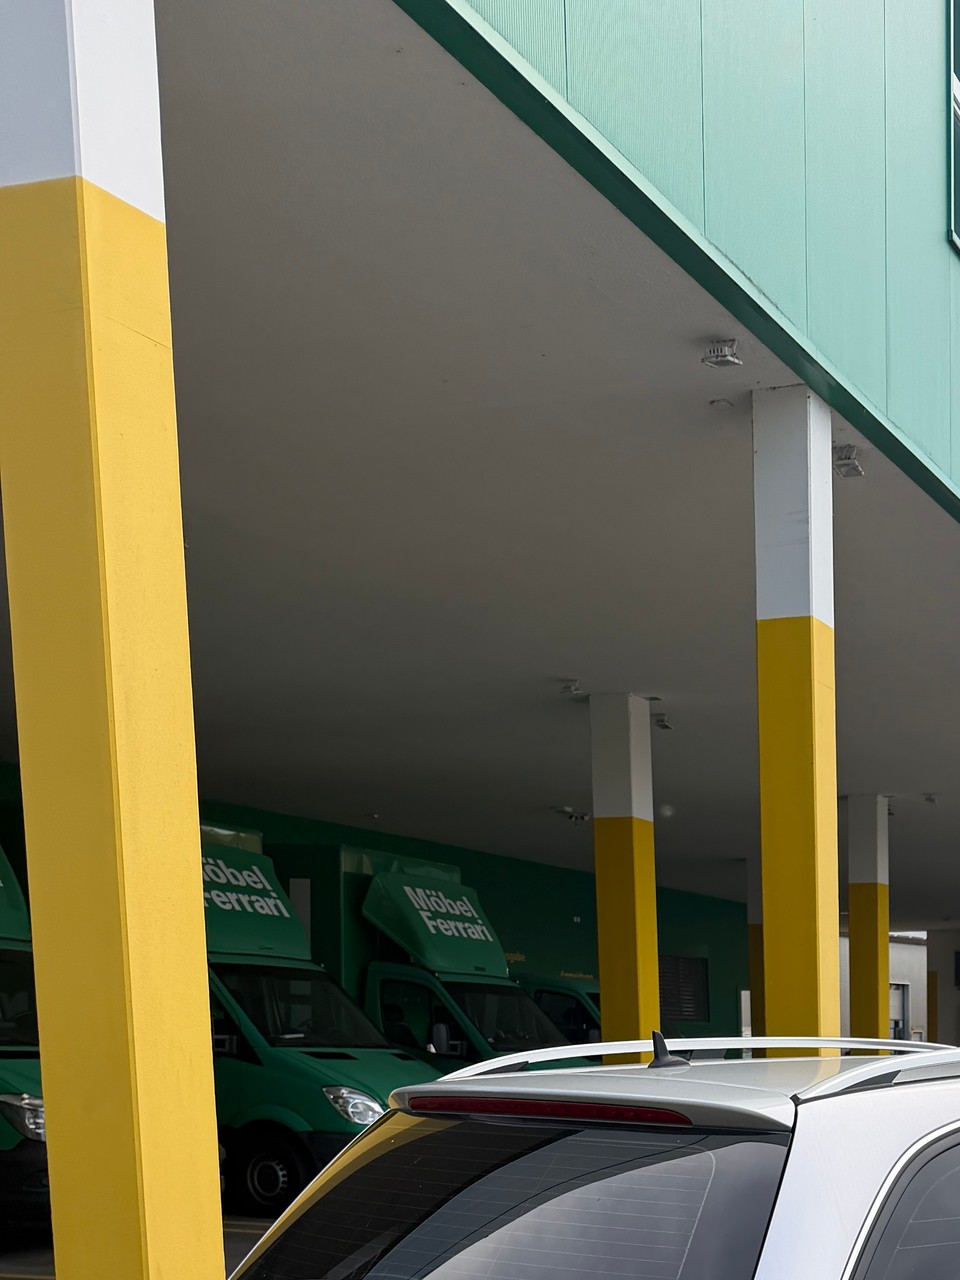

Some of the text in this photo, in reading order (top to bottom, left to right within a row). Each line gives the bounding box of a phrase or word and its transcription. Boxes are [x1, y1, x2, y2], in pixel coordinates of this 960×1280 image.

[202, 856, 273, 891] öbel
[402, 885, 480, 918] Möbel
[418, 910, 494, 942] Ferrari
